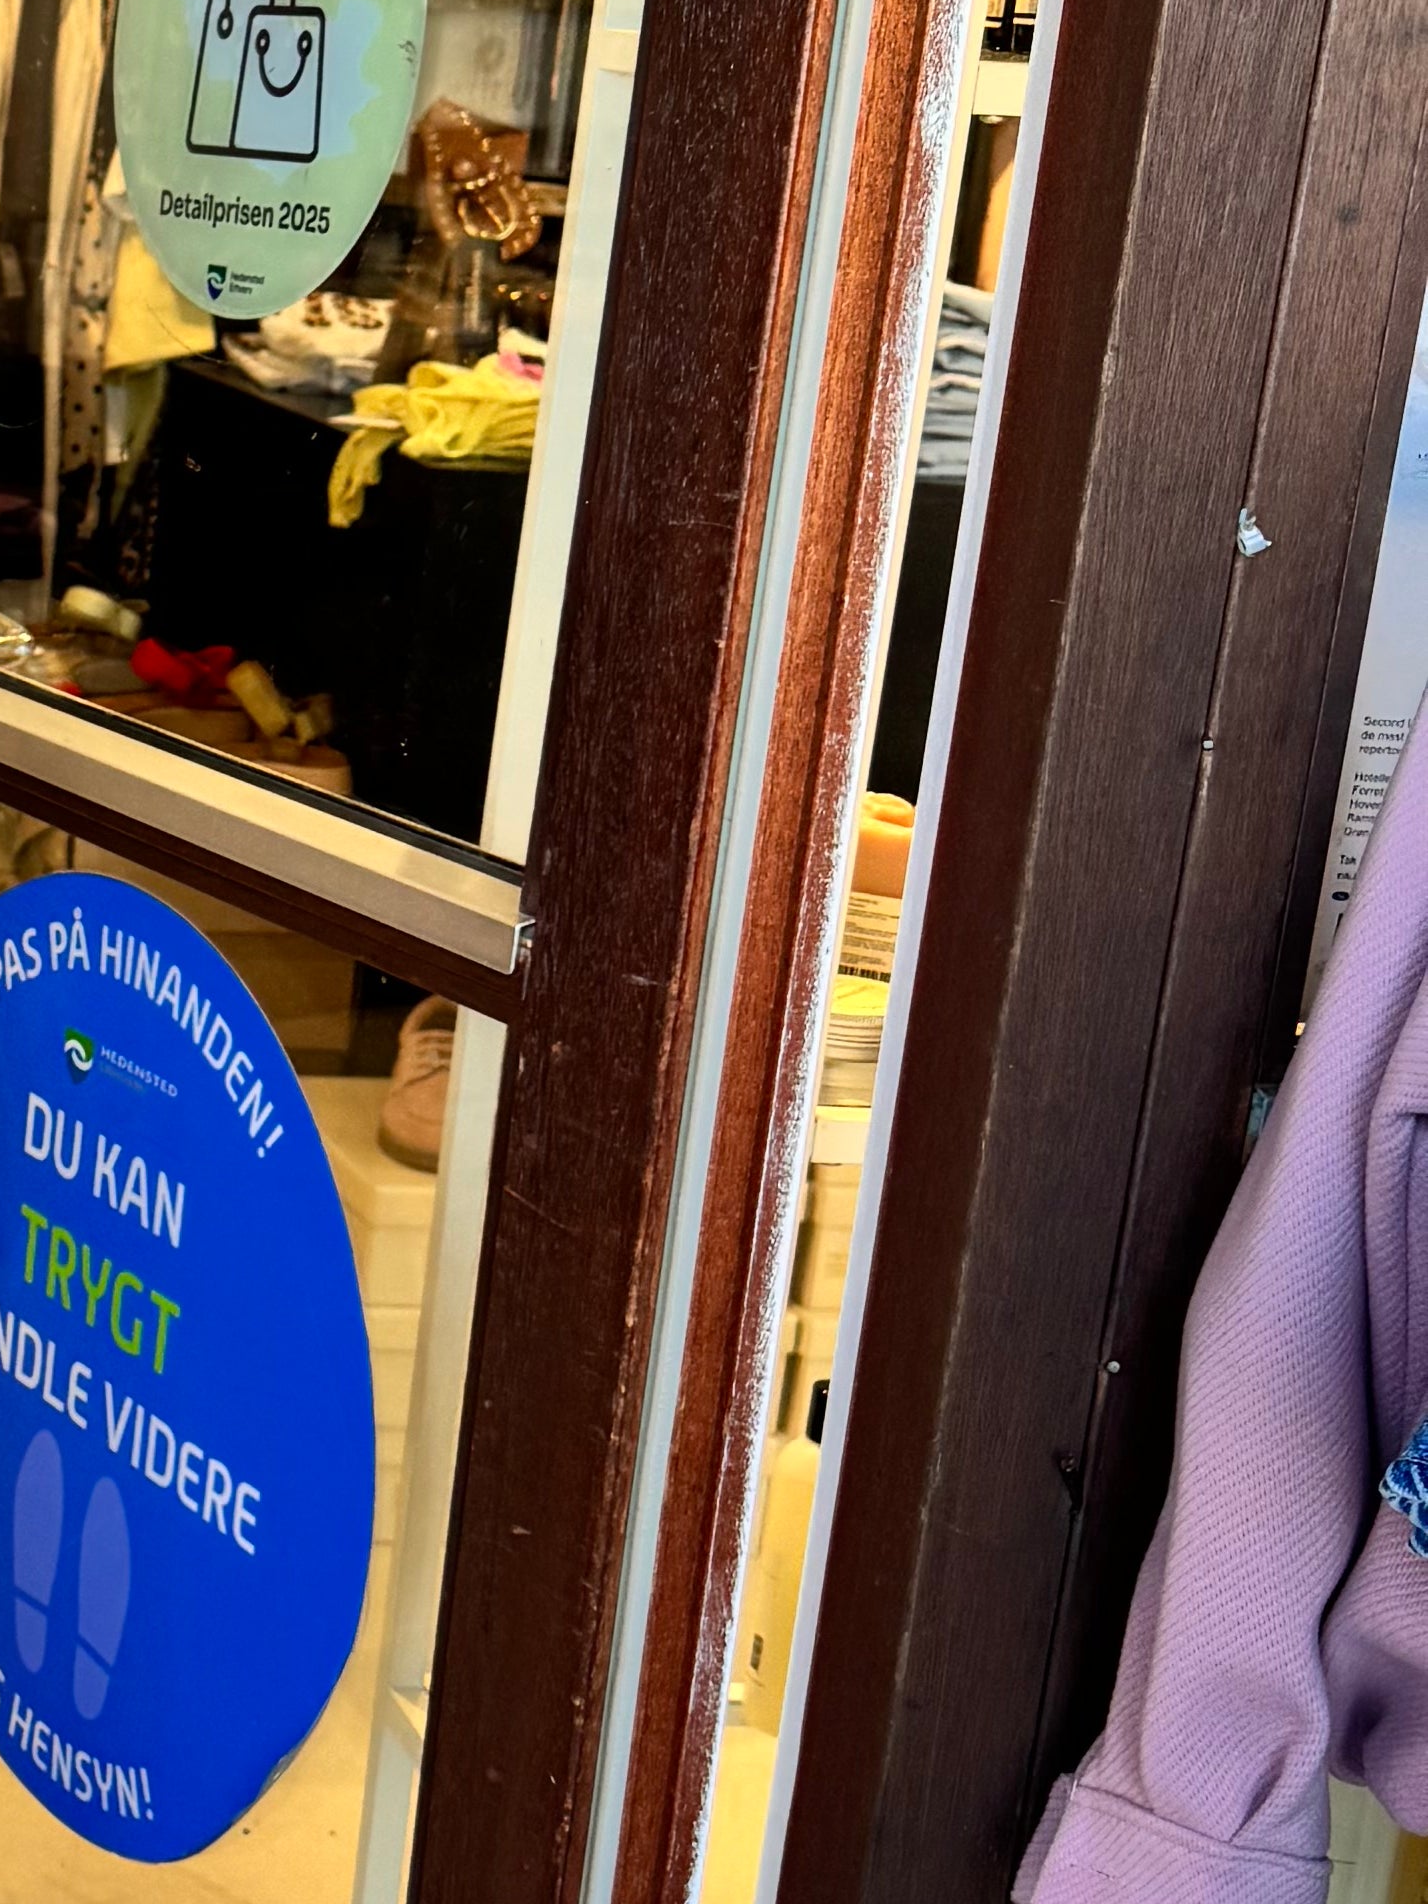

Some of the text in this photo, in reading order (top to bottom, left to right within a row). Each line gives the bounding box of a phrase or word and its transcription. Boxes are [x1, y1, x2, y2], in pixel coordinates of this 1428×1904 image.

[158, 188, 332, 235] Detailprisen 2025
[49, 906, 90, 971] PÅ
[99, 925, 285, 1159] HINANDEN!
[23, 1092, 186, 1249] DU KAN
[20, 1203, 181, 1375] TRYGT
[104, 1381, 262, 1556] VIDERE
[8, 1693, 155, 1821] HENSYN!
